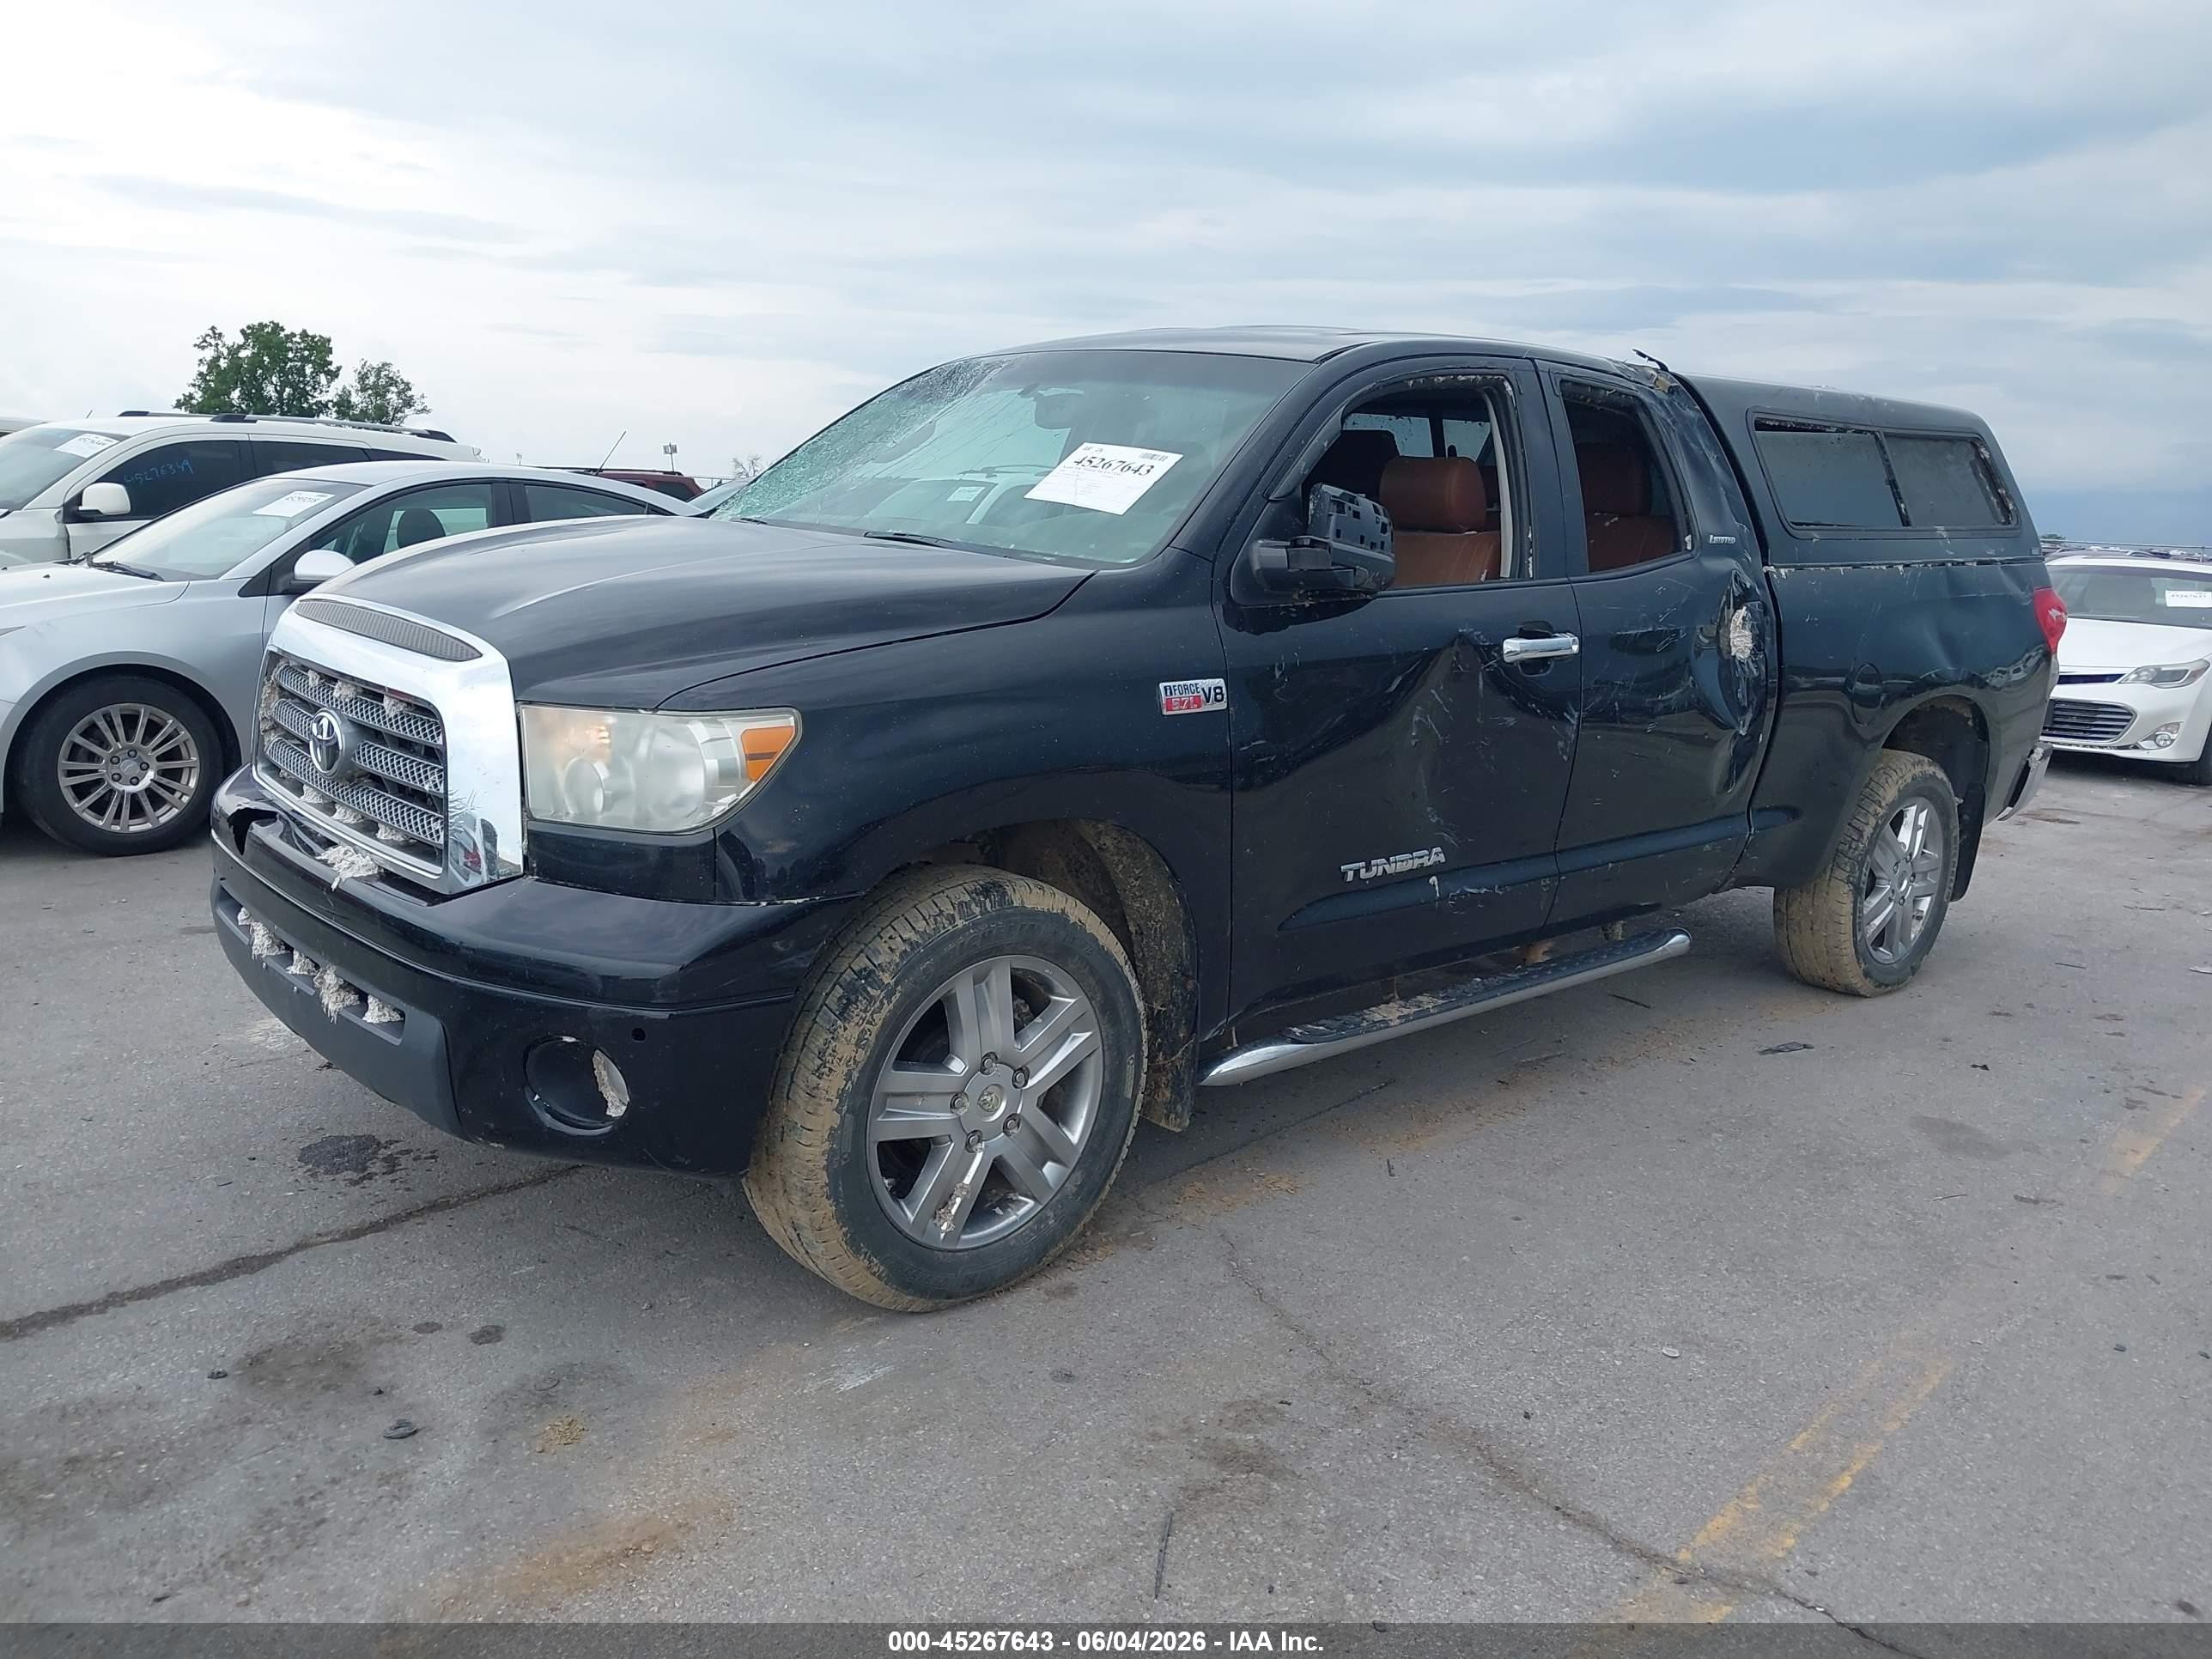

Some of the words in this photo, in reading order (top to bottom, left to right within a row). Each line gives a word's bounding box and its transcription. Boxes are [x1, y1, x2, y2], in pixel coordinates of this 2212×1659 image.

[1073, 454, 1155, 477] 45267643
[1202, 685, 1224, 704] V8
[1340, 846, 1446, 883] TUNDRA
